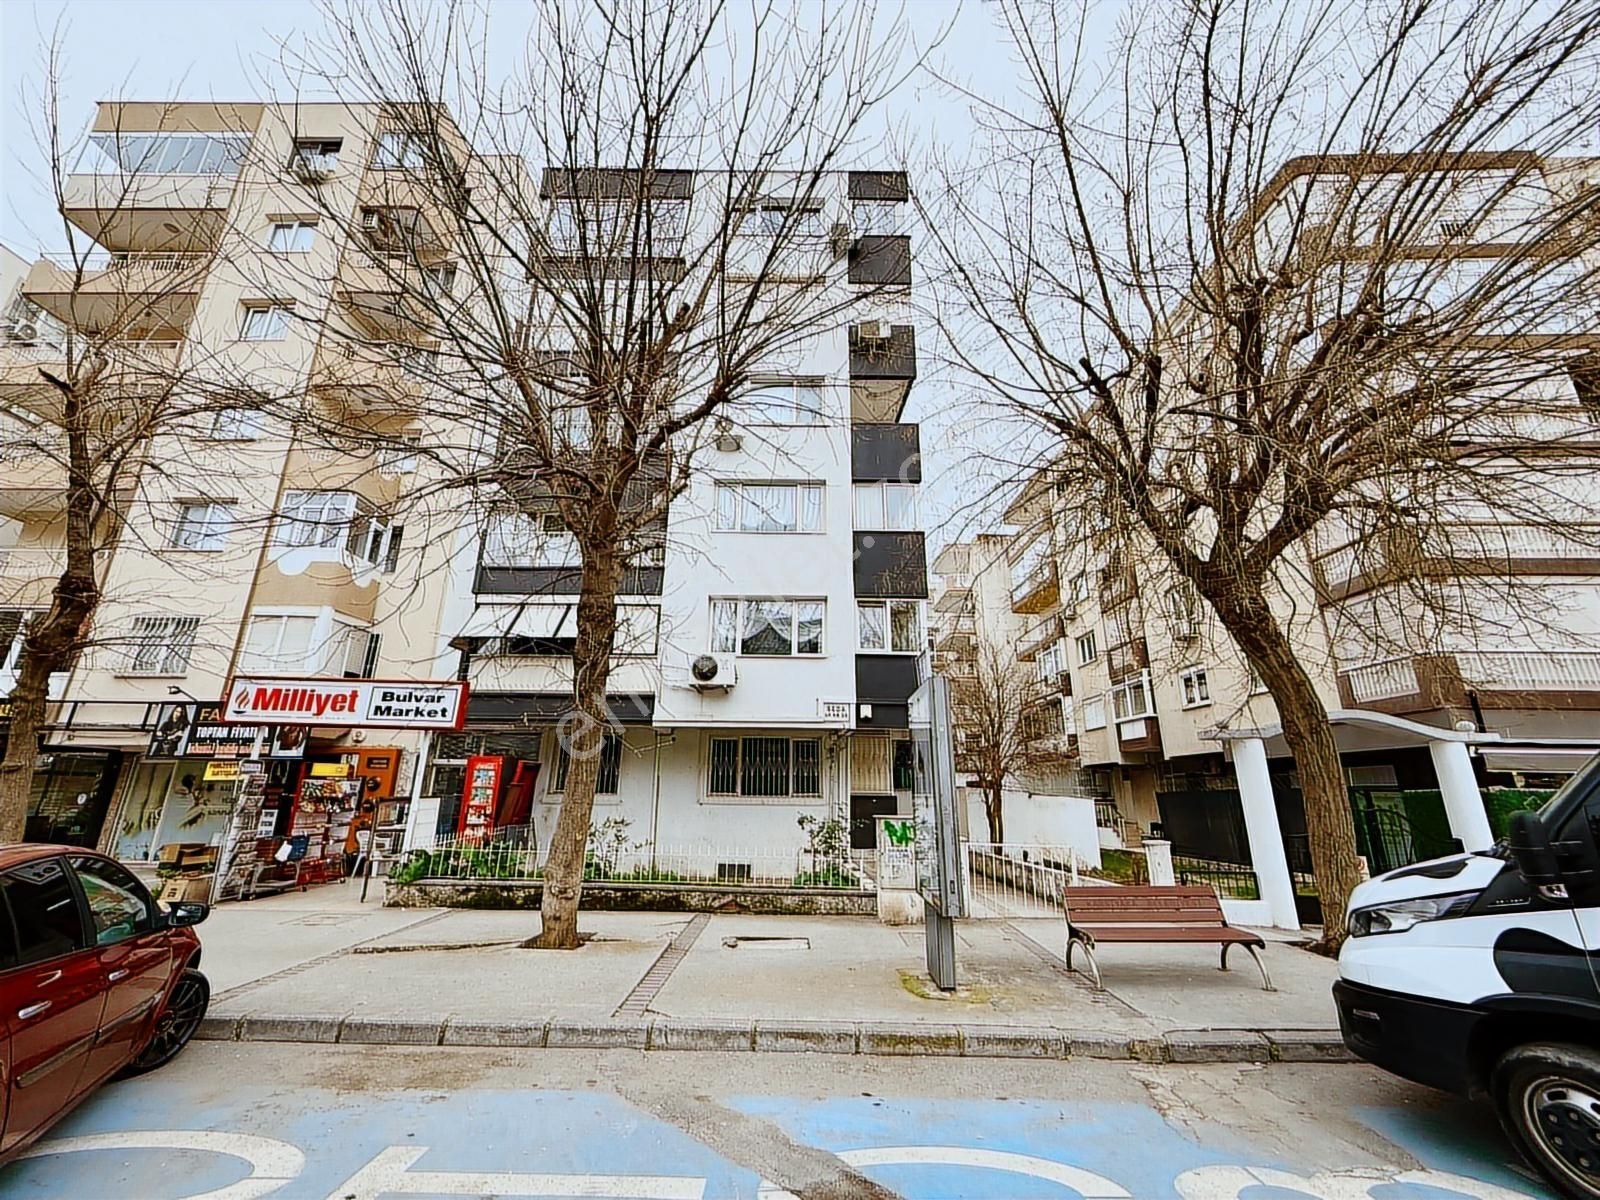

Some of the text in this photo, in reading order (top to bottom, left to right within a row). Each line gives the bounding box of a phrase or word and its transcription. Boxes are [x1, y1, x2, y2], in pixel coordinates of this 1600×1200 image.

[251, 688, 359, 716] Milliyet
[381, 691, 446, 704] Bulvar
[373, 705, 448, 719] Market
[196, 726, 229, 738] TOPTAN
